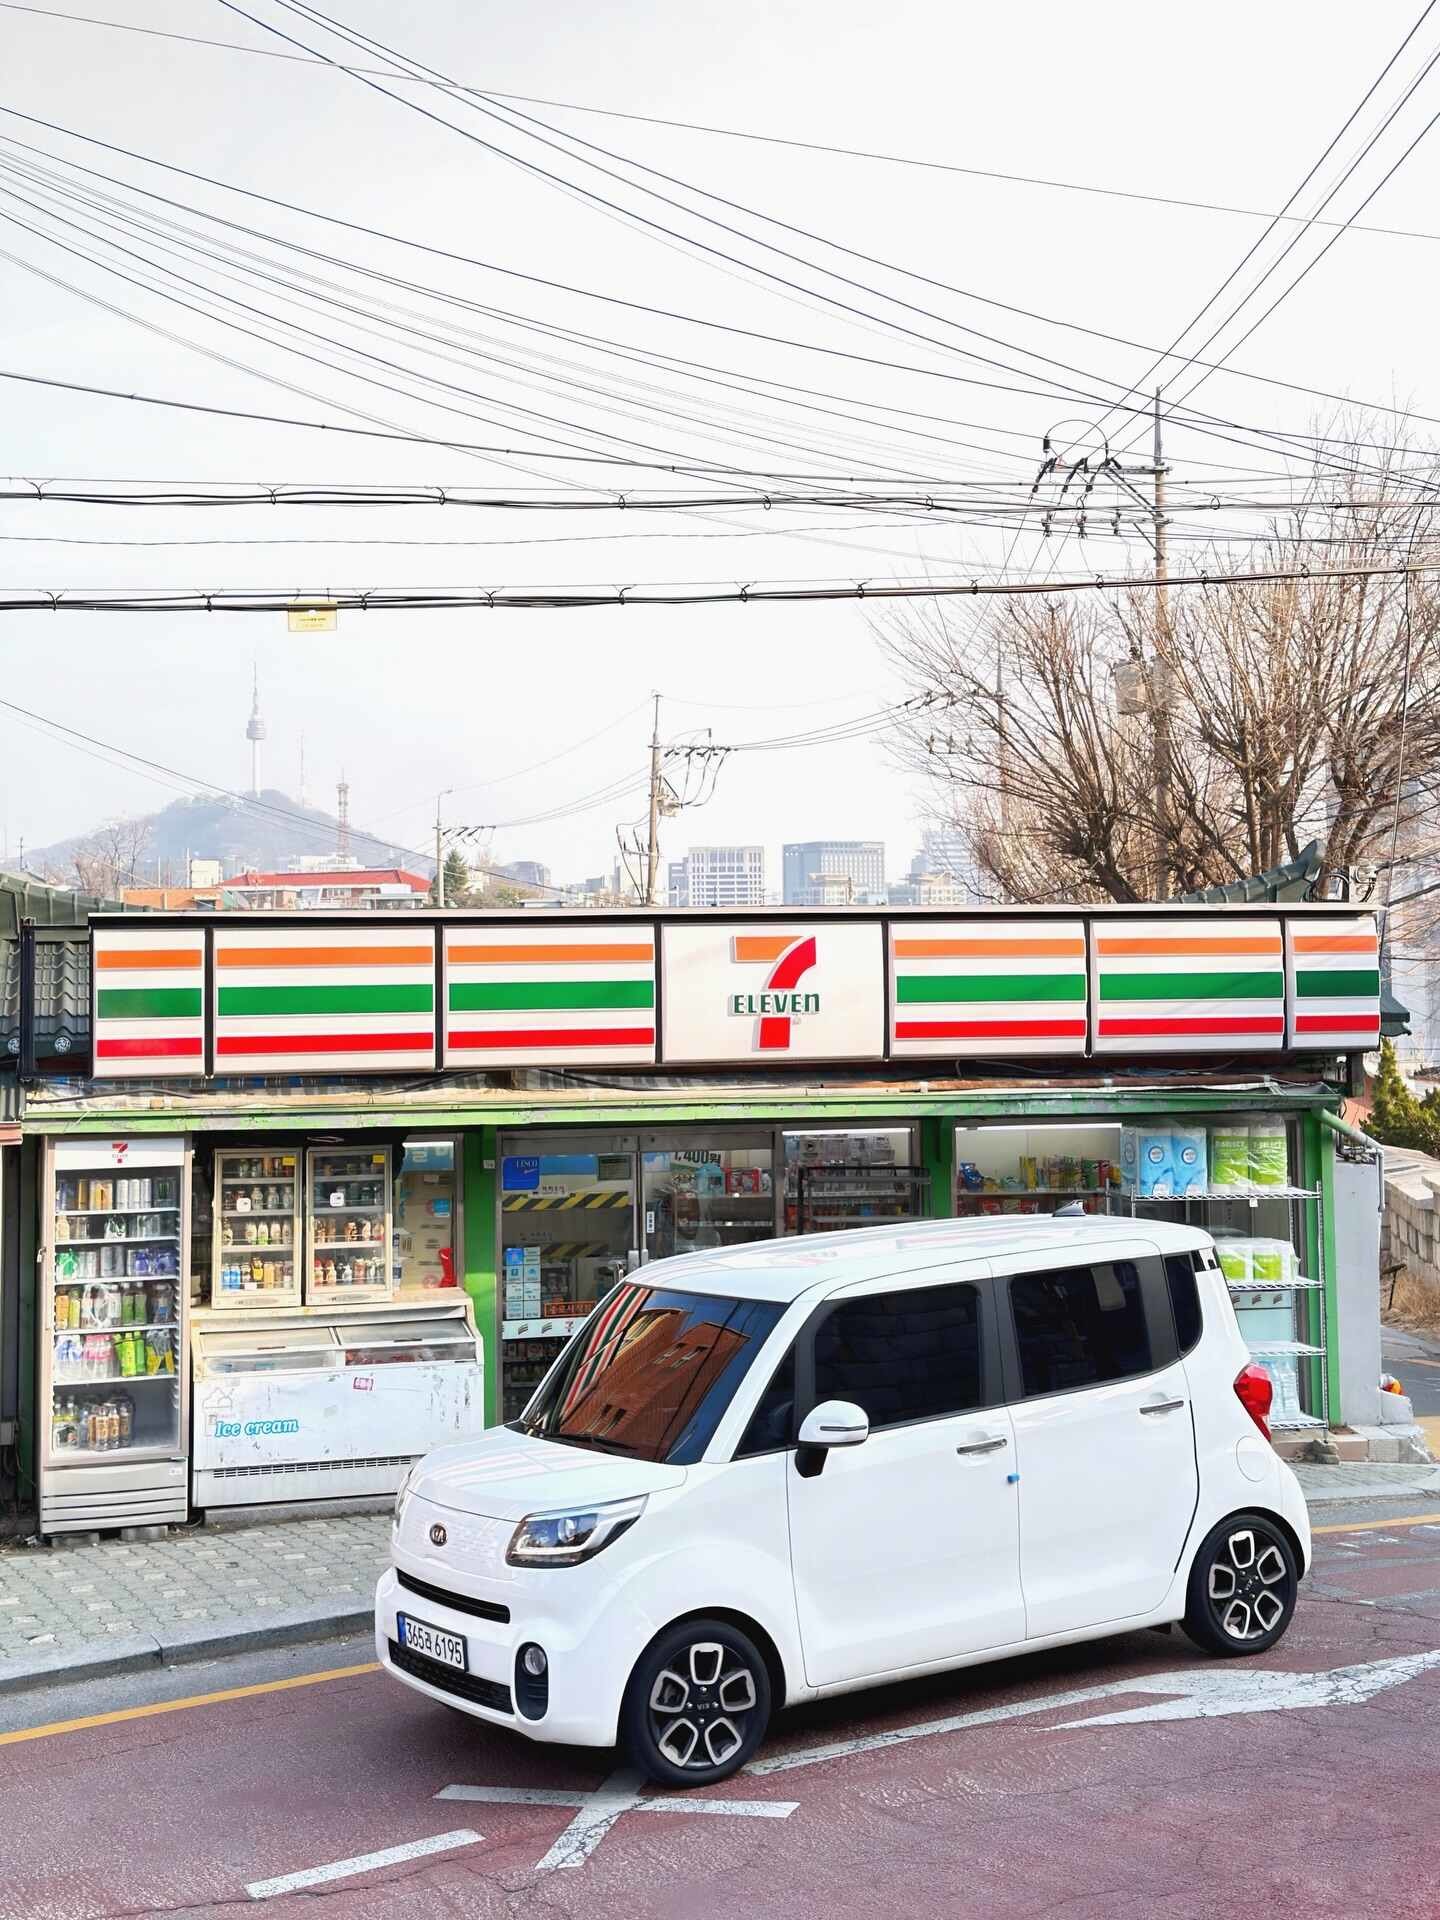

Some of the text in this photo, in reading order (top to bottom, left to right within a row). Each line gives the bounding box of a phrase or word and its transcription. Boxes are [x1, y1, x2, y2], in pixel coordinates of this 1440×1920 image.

[735, 935, 817, 1049] 7
[215, 1419, 299, 1438] Ice cream
[434, 1634, 462, 1665] 6195
